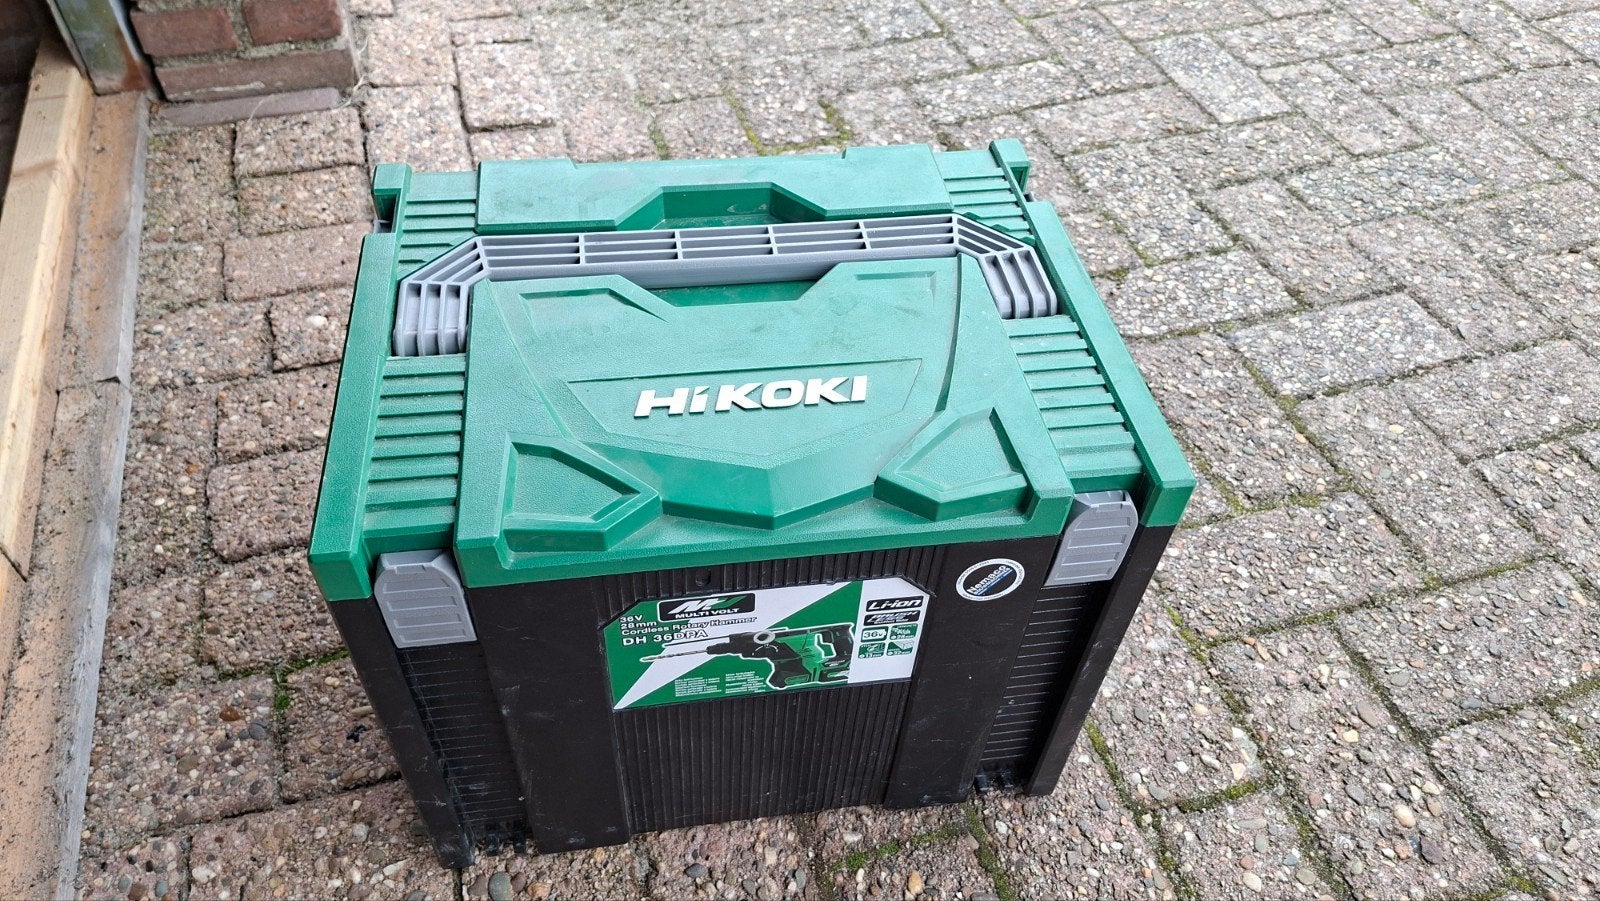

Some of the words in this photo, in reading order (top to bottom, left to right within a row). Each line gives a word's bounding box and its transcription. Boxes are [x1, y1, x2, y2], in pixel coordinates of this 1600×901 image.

[634, 375, 867, 418] HiKOKI
[966, 565, 1007, 594] Nemaco
[868, 599, 922, 610] Li-ion
[620, 615, 643, 623] 36V
[675, 610, 710, 619] MULTI
[620, 621, 657, 630] 28mm
[621, 625, 670, 636] Cordless
[672, 620, 709, 630] Rotary
[710, 617, 758, 627] Hammer
[622, 636, 647, 646] DH
[653, 630, 709, 643] 36DPA
